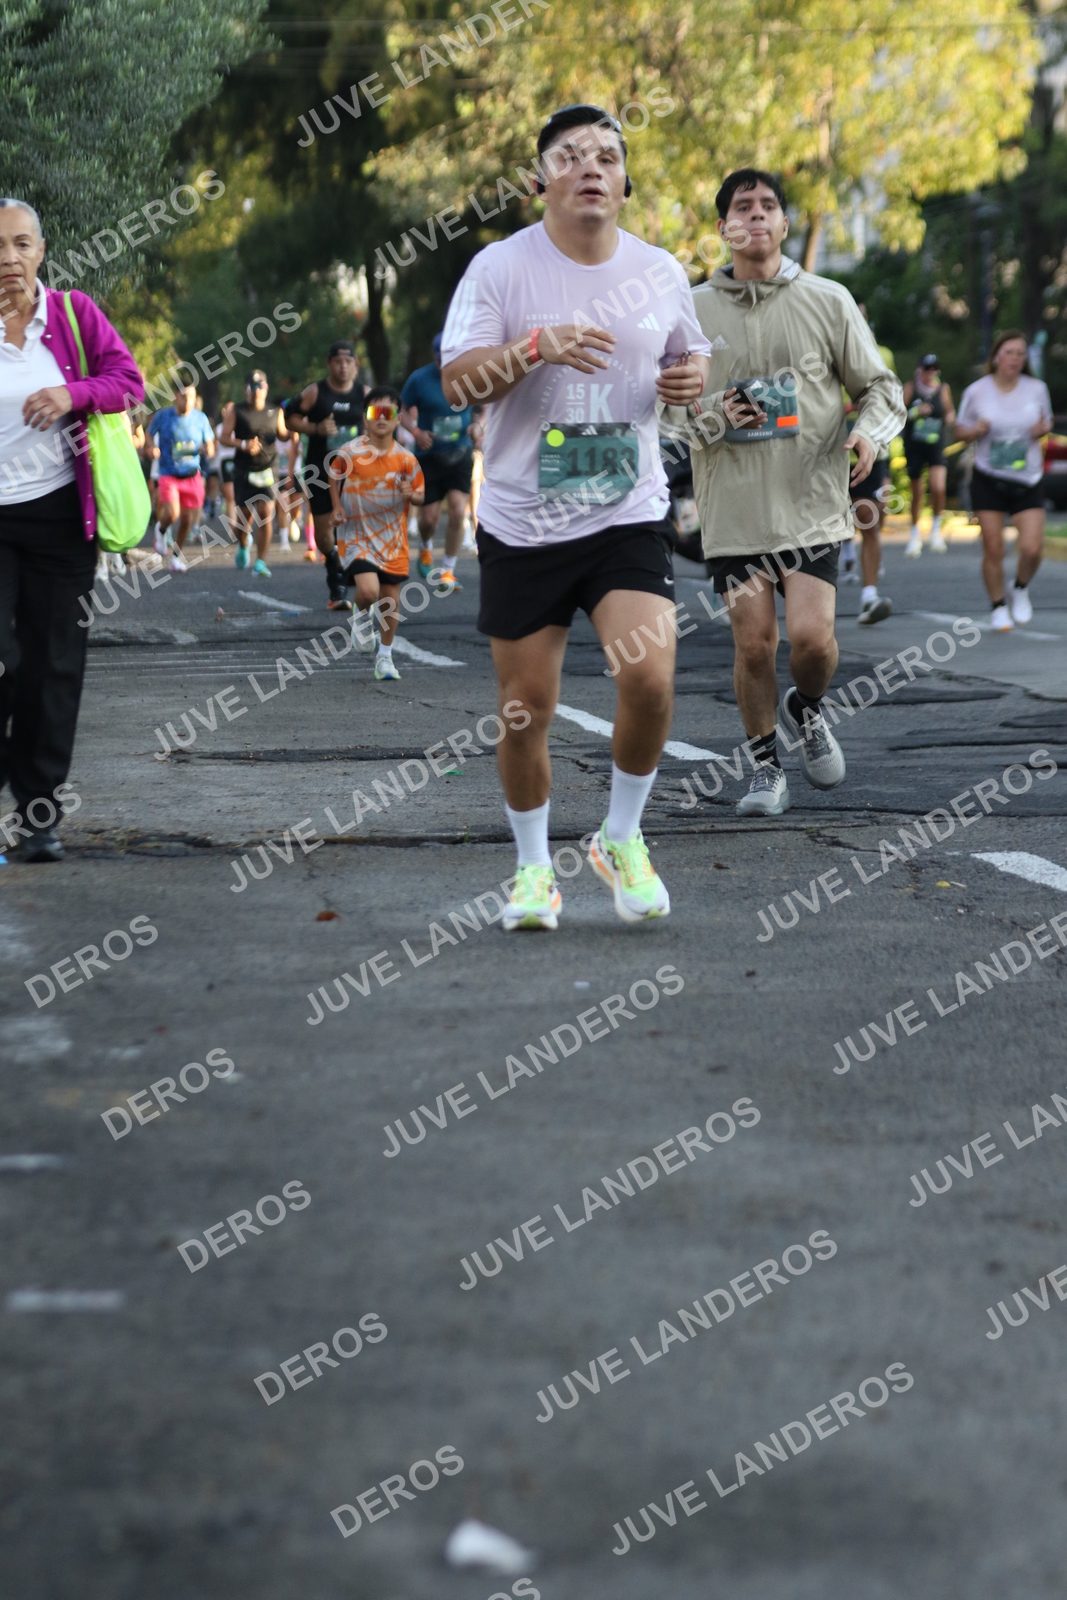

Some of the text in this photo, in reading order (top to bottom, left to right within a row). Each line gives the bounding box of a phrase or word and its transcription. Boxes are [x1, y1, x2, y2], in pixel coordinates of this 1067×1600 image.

[566, 383, 585, 400] 15
[590, 383, 614, 423] K
[566, 406, 585, 423] 30
